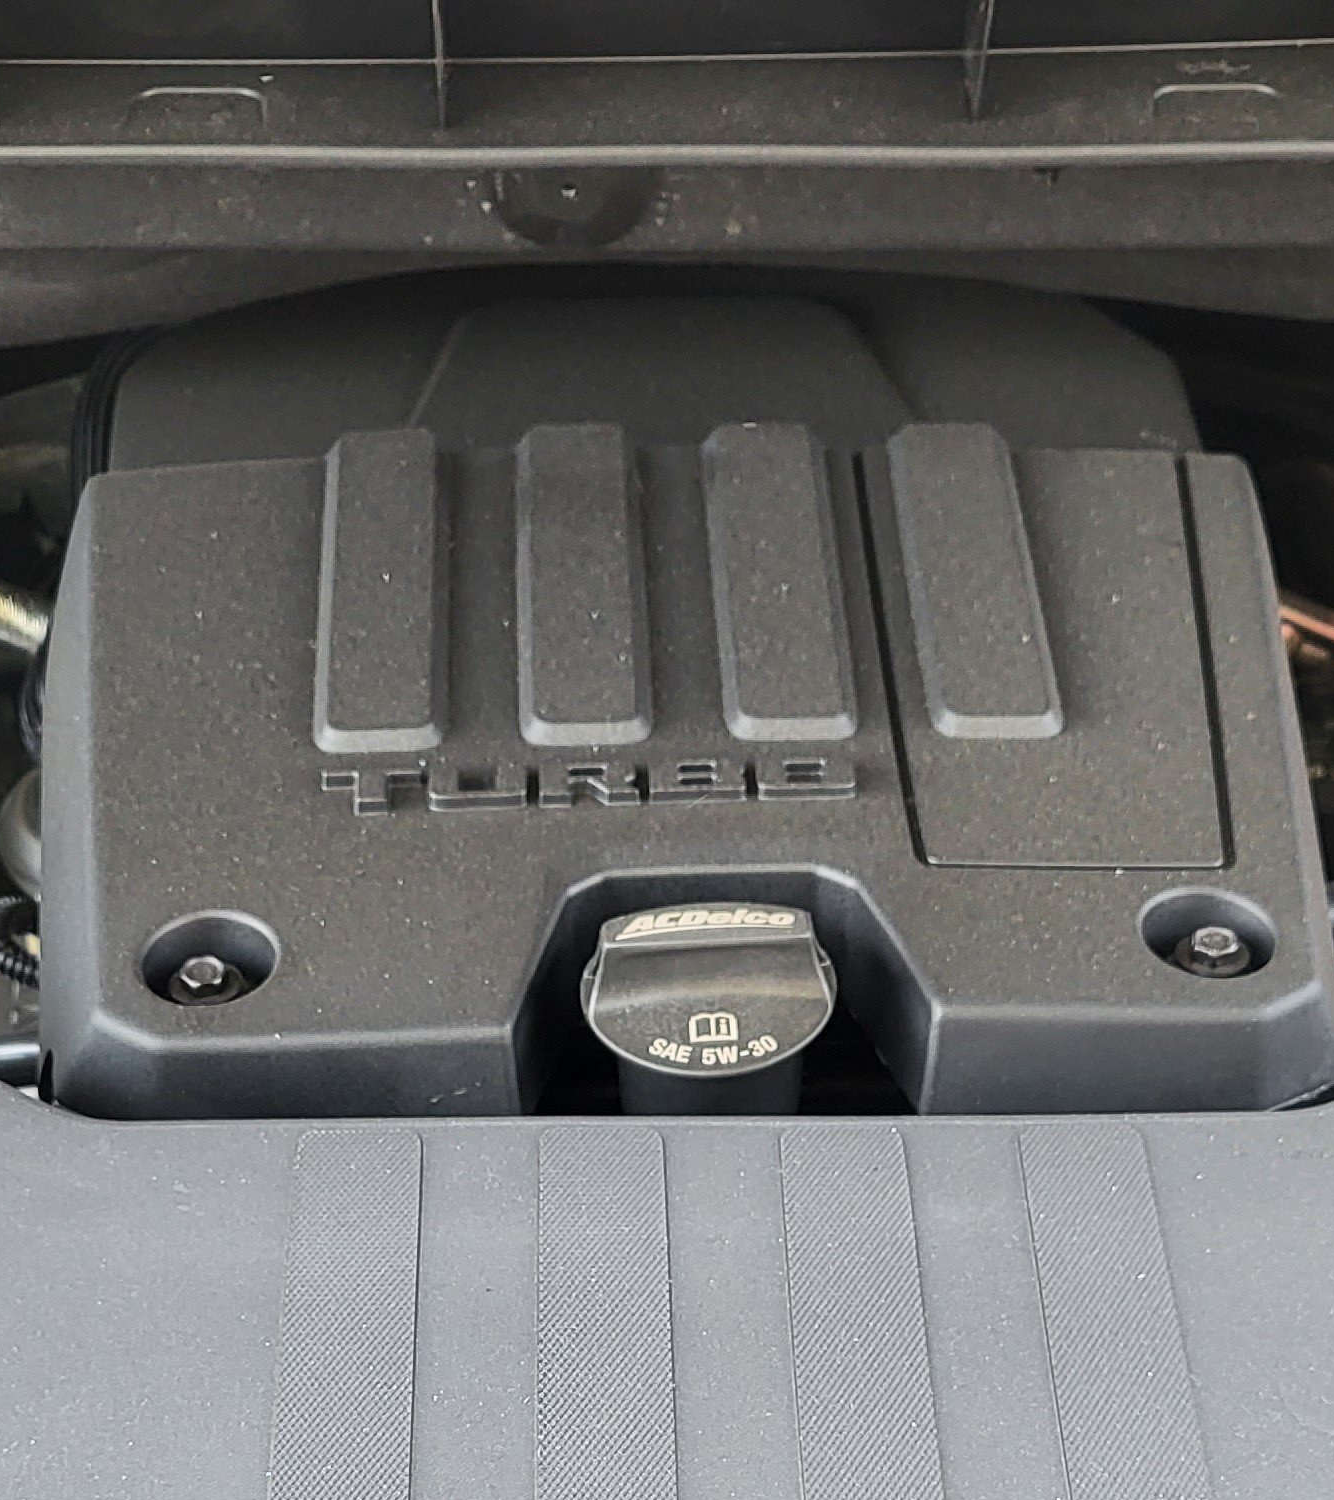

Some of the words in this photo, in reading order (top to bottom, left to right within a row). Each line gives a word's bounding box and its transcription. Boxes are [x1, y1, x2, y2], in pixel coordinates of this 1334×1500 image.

[320, 756, 856, 816] TURBO
[621, 908, 796, 935] ACDelco
[648, 1037, 694, 1064] SAE
[701, 1034, 779, 1066] 5W-30
